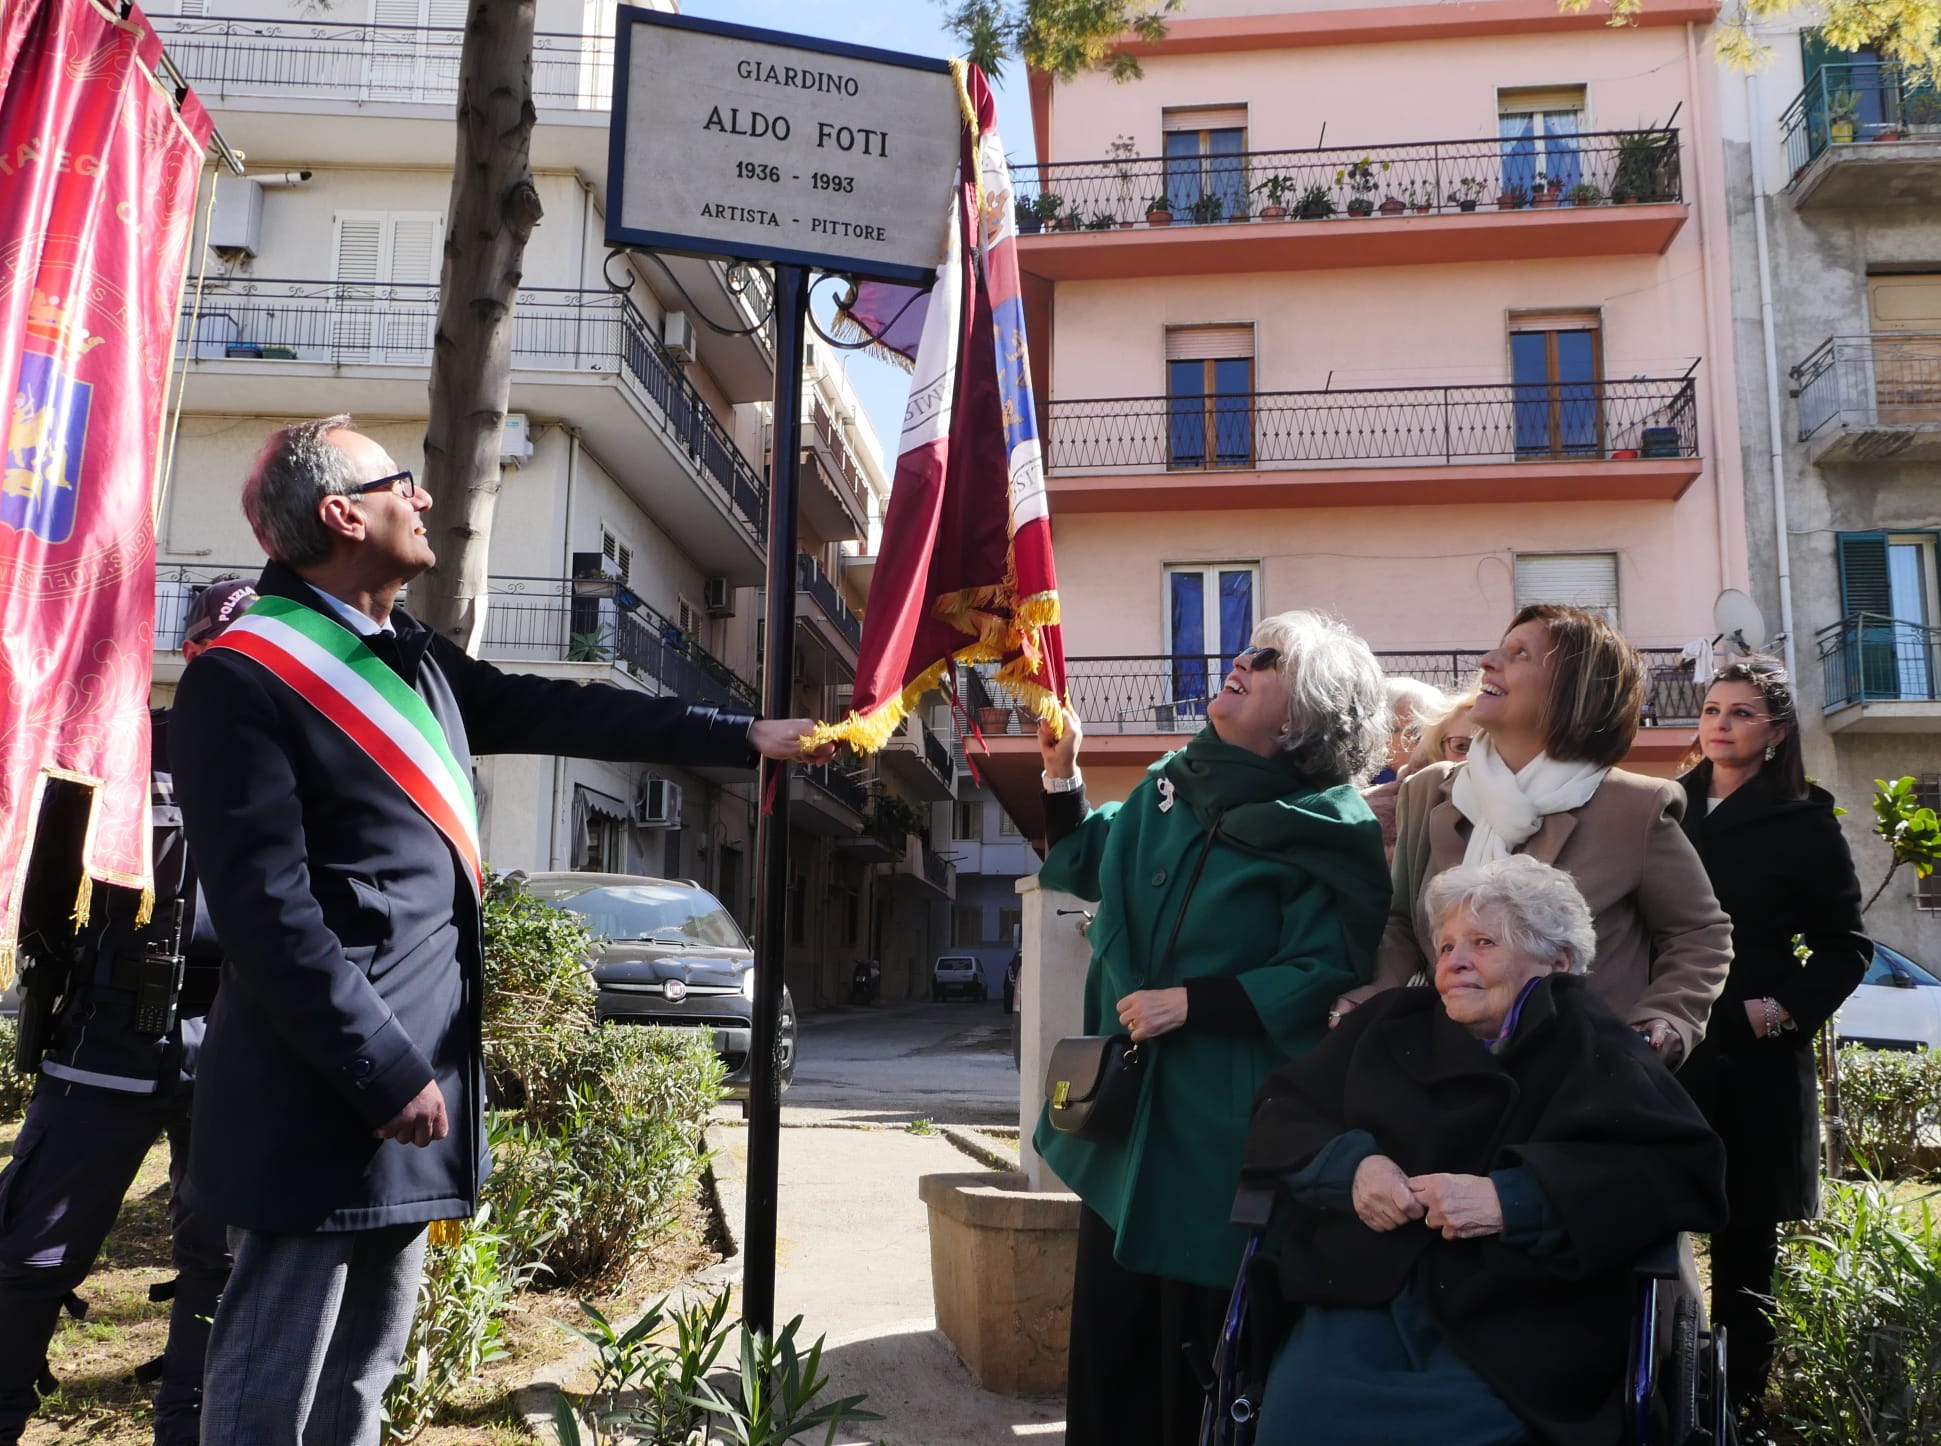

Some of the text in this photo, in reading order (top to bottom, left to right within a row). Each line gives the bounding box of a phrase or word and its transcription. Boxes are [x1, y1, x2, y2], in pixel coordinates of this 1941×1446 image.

[737, 60, 859, 97] GIARDINO
[703, 105, 888, 158] ALDO FOTI
[736, 160, 781, 184] 1936
[811, 172, 855, 194] 1993
[700, 202, 780, 227] ARTISTA
[811, 218, 886, 242] PITTORE
[218, 585, 257, 622] POLIZIA
